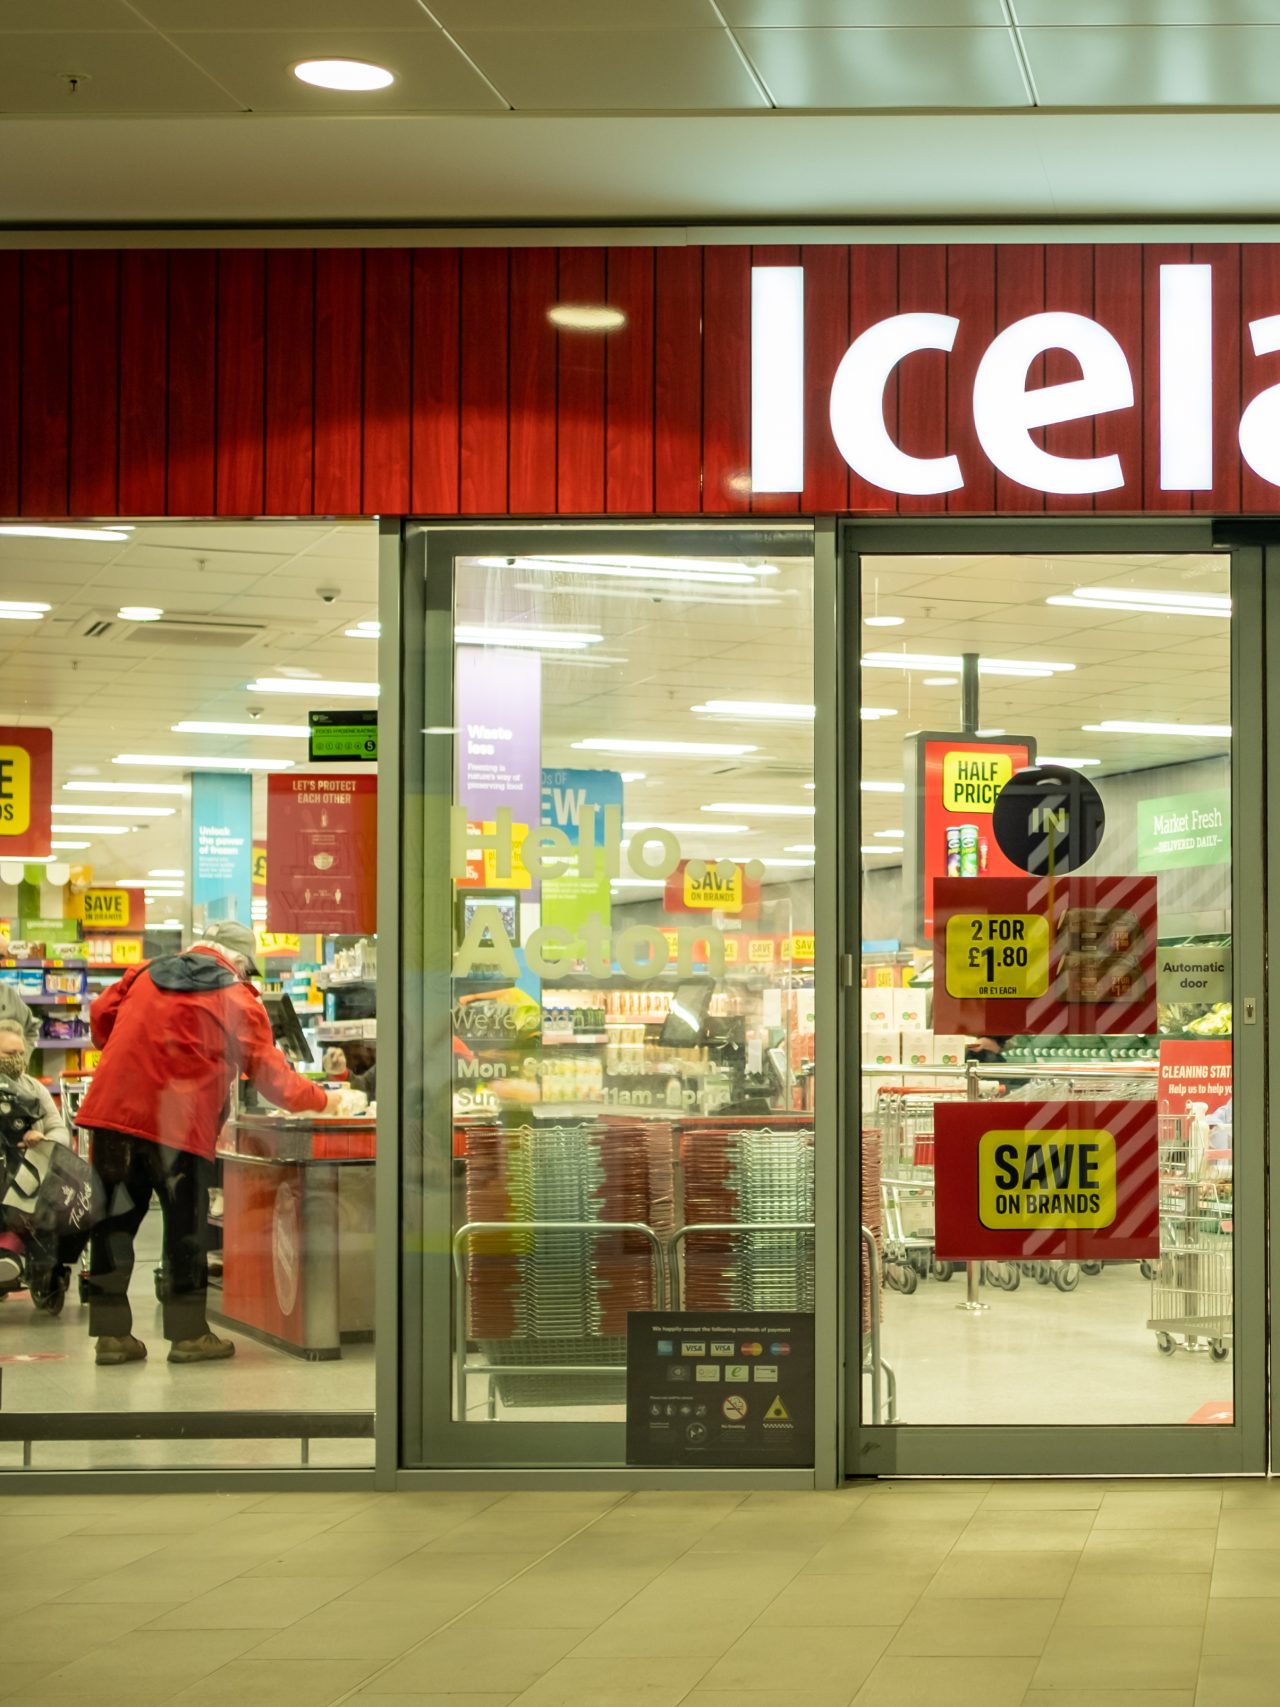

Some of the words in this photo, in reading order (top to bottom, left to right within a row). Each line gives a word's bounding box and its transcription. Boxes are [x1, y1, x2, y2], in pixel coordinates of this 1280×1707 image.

[467, 724, 512, 741] Waste
[467, 740, 495, 755] less
[958, 760, 998, 781] HALF
[292, 780, 316, 792] LET'S
[318, 780, 357, 792] PROTECT
[297, 793, 322, 804] EACH
[323, 793, 352, 804] OTHER
[1032, 807, 1066, 833] IN
[1153, 814, 1190, 836] Market
[1191, 807, 1222, 830] Fresh
[85, 895, 122, 912] SAVE
[703, 892, 735, 902] BRANDS
[971, 919, 983, 941] 2
[988, 919, 1025, 941] FOR
[450, 903, 725, 980] Acton
[968, 945, 1028, 983] £1.80
[1163, 962, 1225, 973] Automatic
[978, 986, 988, 995] OR
[999, 986, 1017, 995] EACH
[1180, 978, 1208, 989] door
[457, 1058, 507, 1079] Mon
[1162, 1065, 1209, 1079] CLEANING
[1210, 1065, 1232, 1078] STAT
[457, 1087, 500, 1107] Sun
[1168, 1083, 1187, 1096] Help
[1188, 1086, 1197, 1094] us
[1198, 1084, 1207, 1094] to
[1207, 1083, 1224, 1096] help
[994, 1143, 1100, 1190] SAVE
[995, 1194, 1020, 1214] ON
[1026, 1193, 1100, 1214] BRANDS
[714, 1344, 731, 1352] VISA
